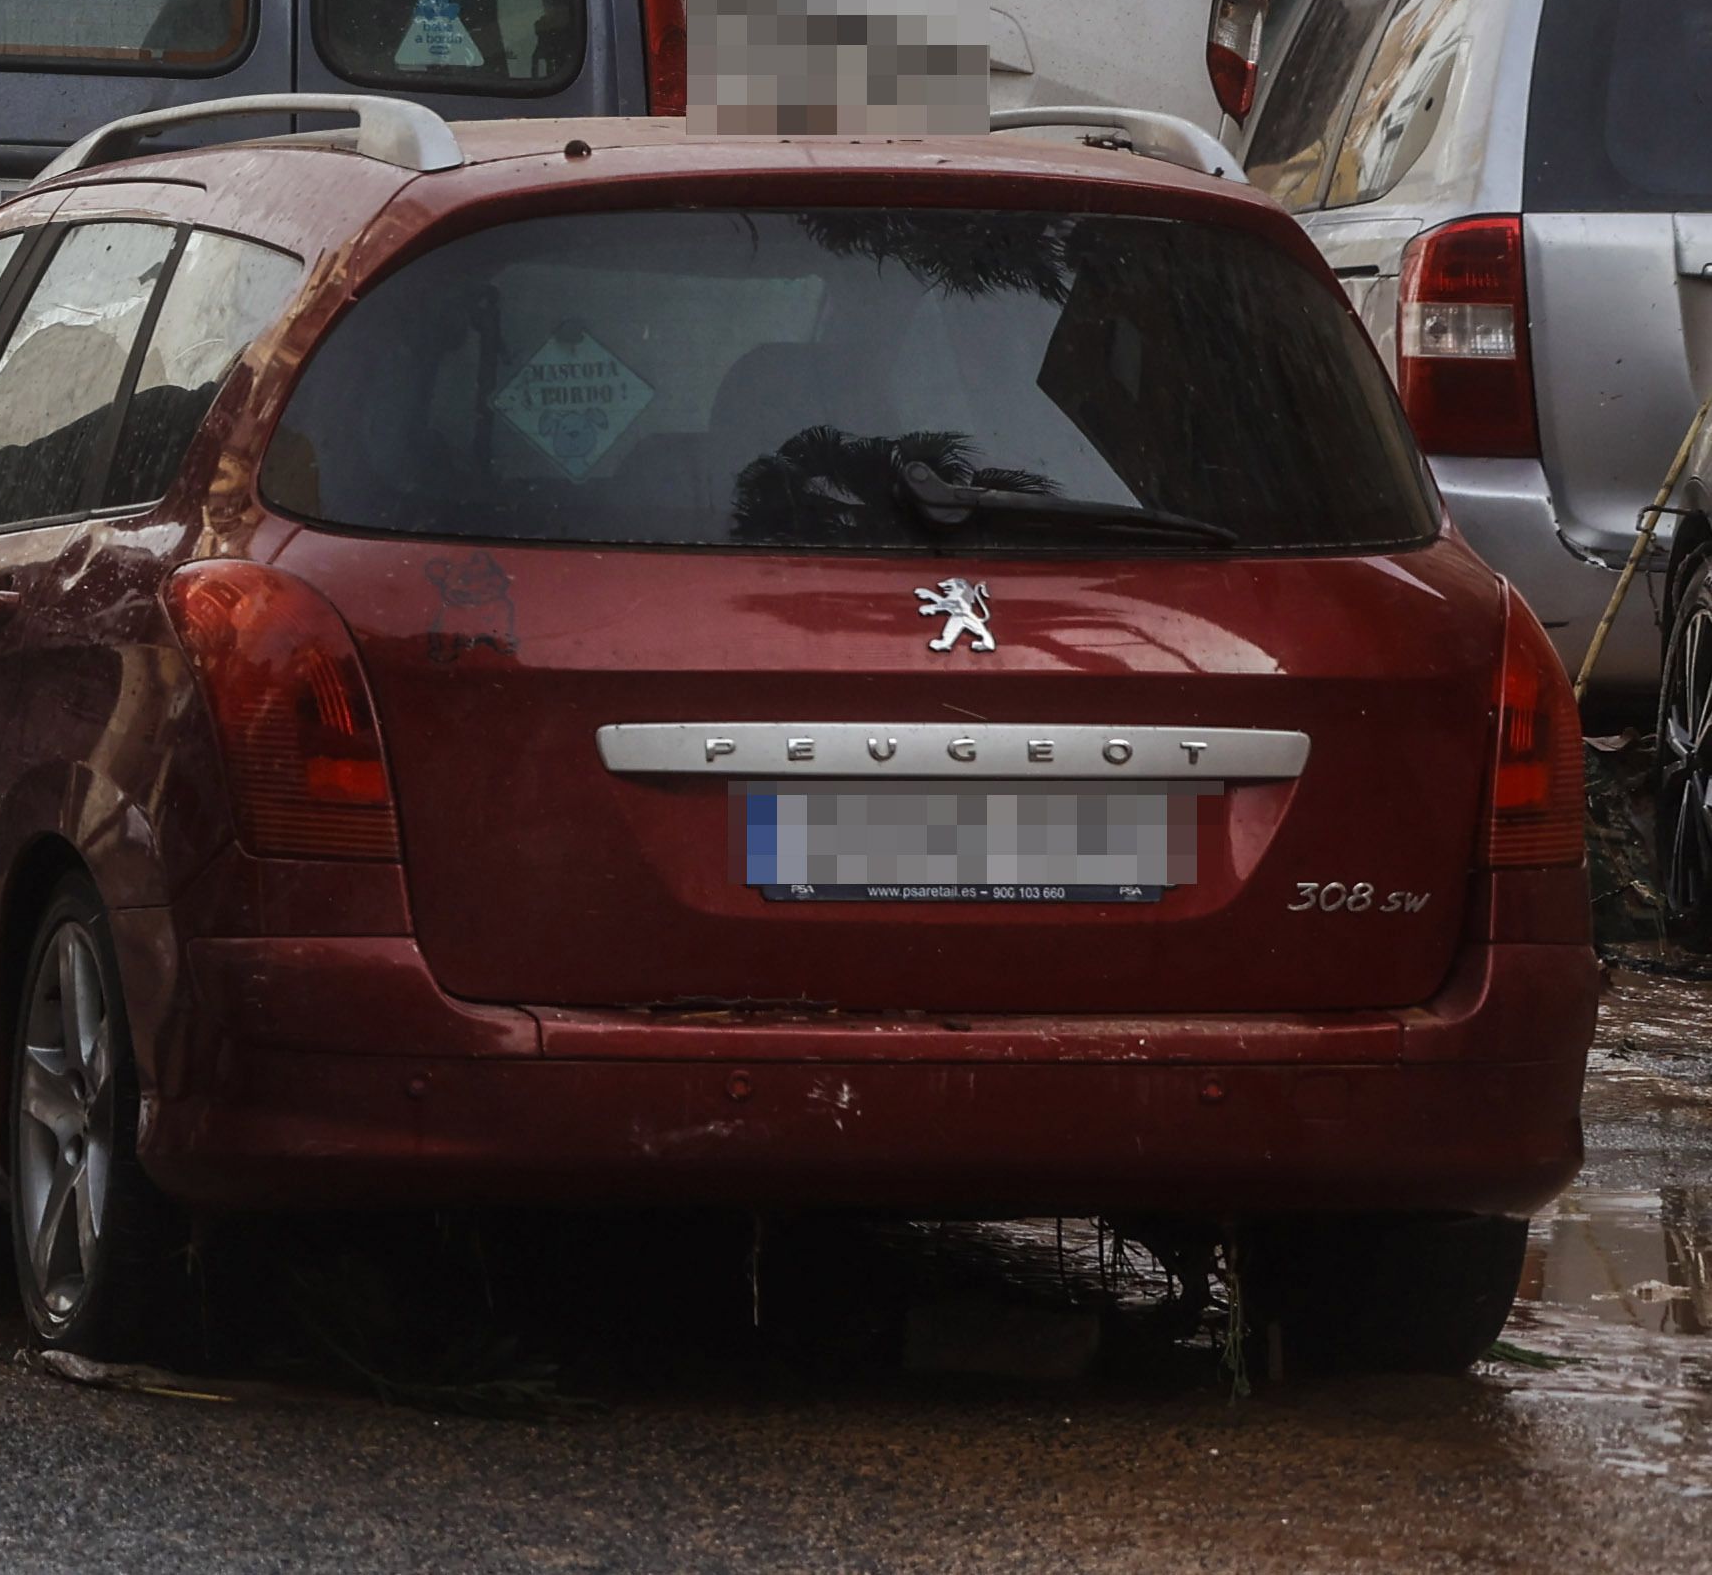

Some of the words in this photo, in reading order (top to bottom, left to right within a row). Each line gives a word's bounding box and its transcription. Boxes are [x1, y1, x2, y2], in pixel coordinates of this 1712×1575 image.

[426, 33, 463, 43] bordo
[705, 736, 1208, 766] PEUGEOT
[867, 885, 977, 899] www.psaretail.es
[993, 886, 1015, 898] 900
[1019, 886, 1040, 898] 103
[1043, 886, 1066, 899] 660
[1119, 886, 1143, 896] PSA
[1287, 881, 1375, 912] 308
